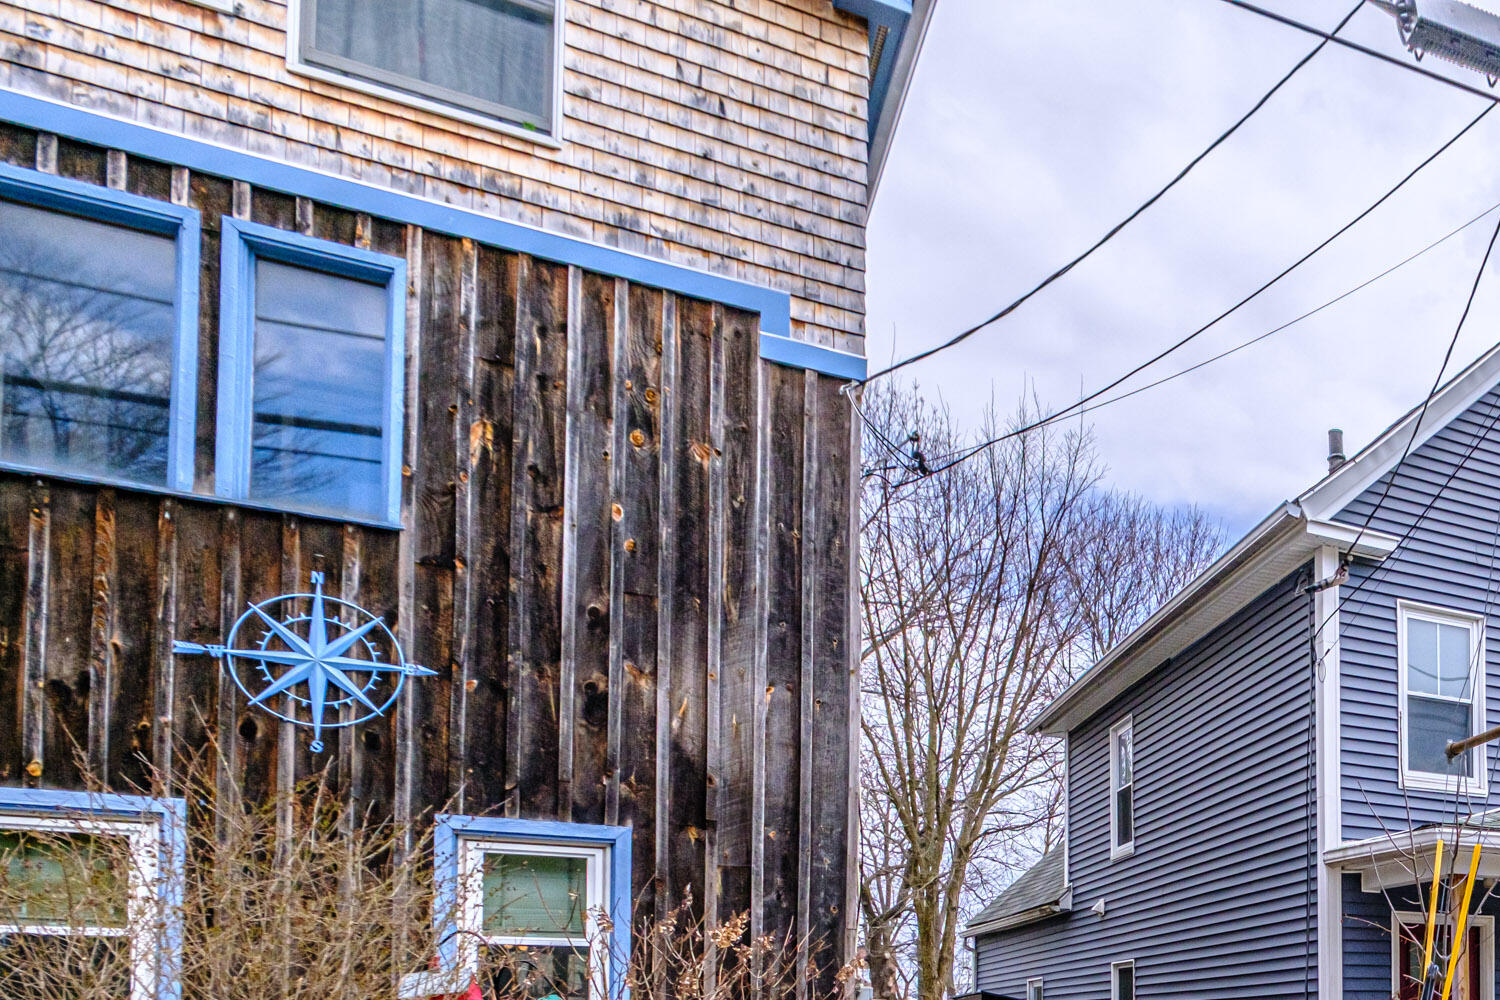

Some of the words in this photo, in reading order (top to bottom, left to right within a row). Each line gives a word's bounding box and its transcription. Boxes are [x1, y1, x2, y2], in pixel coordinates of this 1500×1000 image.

[311, 570, 325, 584] N
[206, 644, 225, 658] W
[404, 663, 417, 675] E
[310, 740, 324, 753] S
